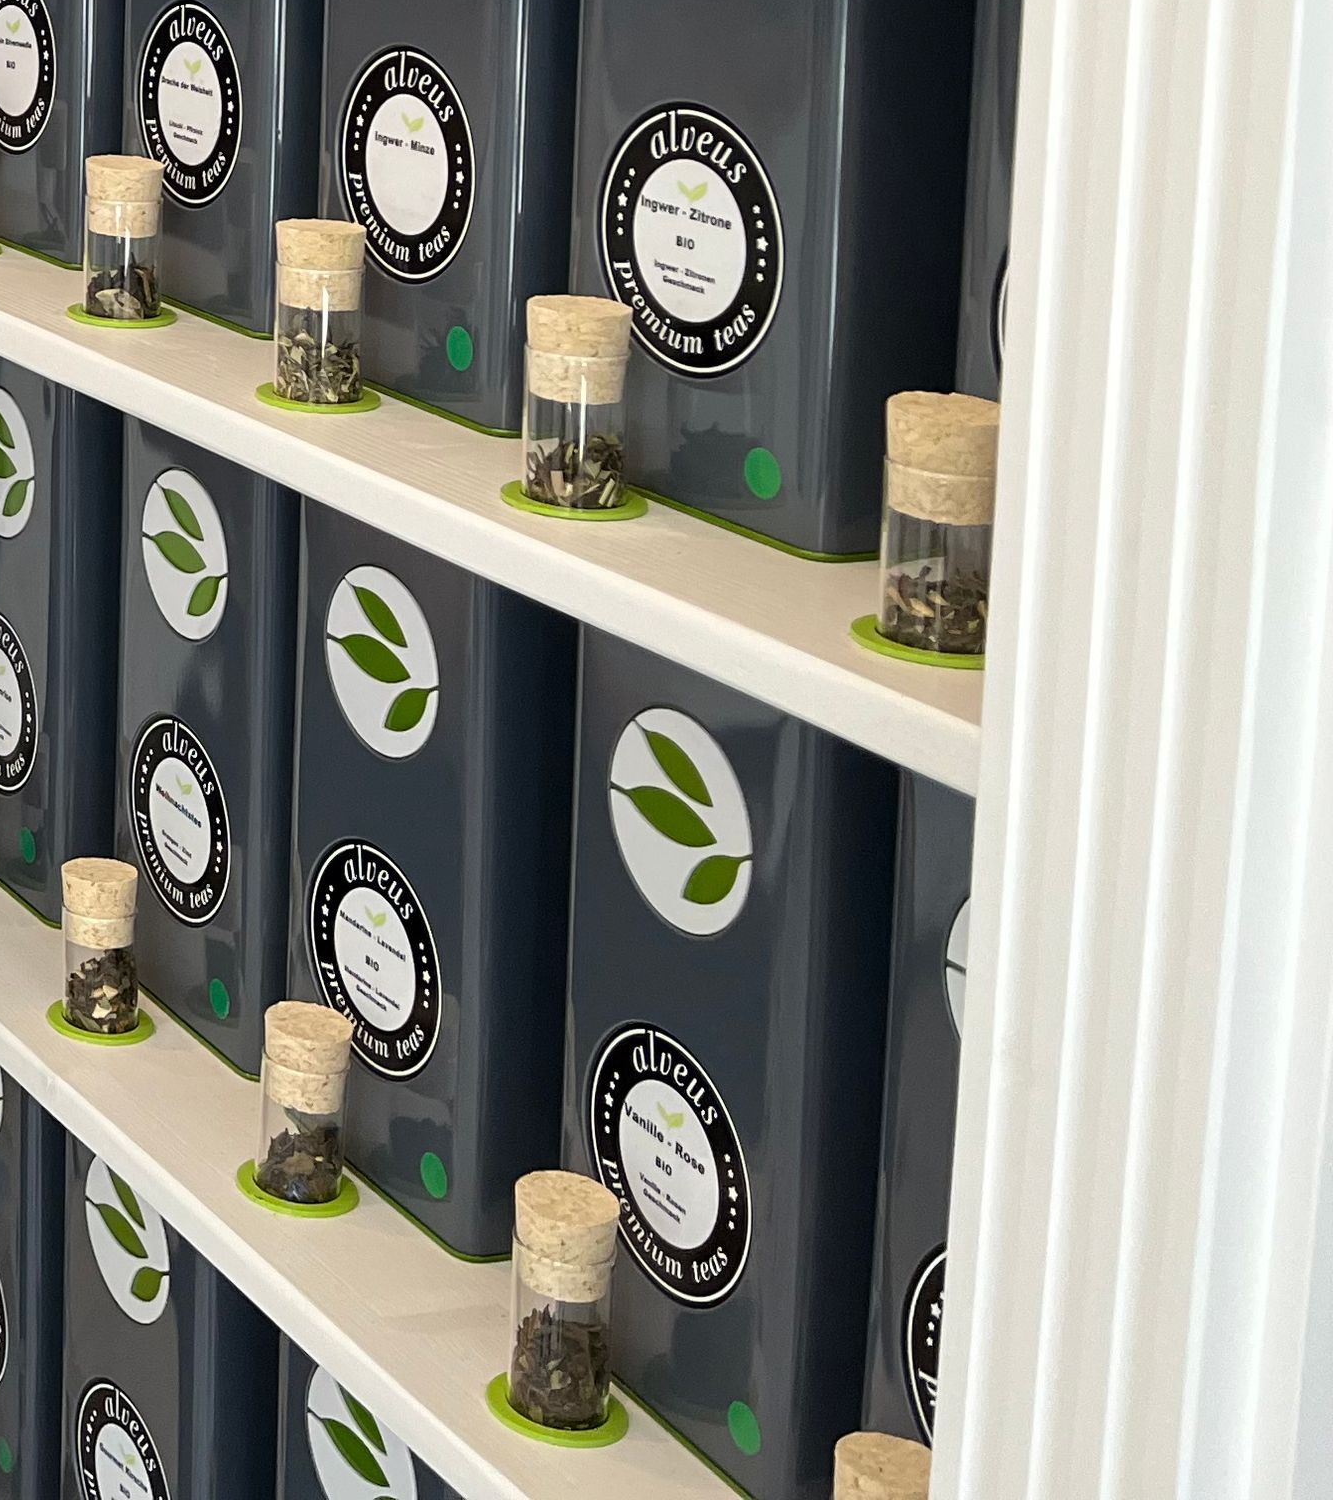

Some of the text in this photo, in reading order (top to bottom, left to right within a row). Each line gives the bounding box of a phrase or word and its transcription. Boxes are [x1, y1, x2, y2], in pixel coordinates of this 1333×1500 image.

[6, 60, 15, 69] BIO
[169, 5, 224, 61] alveus
[25, 98, 45, 134] teas
[384, 51, 454, 123] alveus
[146, 119, 226, 190] premium teas
[375, 131, 404, 147] Ingwer
[650, 110, 747, 184] alveus
[349, 171, 451, 263] premium teas
[641, 194, 680, 216] Ingwer
[689, 207, 732, 230] Zitrone
[676, 235, 695, 250] BIO
[613, 259, 757, 355] premium teas
[6, 752, 26, 778] teas
[162, 721, 215, 796] alveus
[137, 810, 184, 905] premium
[189, 883, 213, 909] teas
[344, 845, 414, 920] alveus
[365, 955, 380, 973] BIO
[396, 1024, 425, 1060] teas
[633, 1029, 718, 1126] alveus
[624, 1100, 664, 1142] Vanille
[675, 1142, 705, 1175] Rose
[655, 1156, 673, 1176] BIO
[602, 1155, 728, 1284] premium teas
[105, 1388, 156, 1472] alveus
